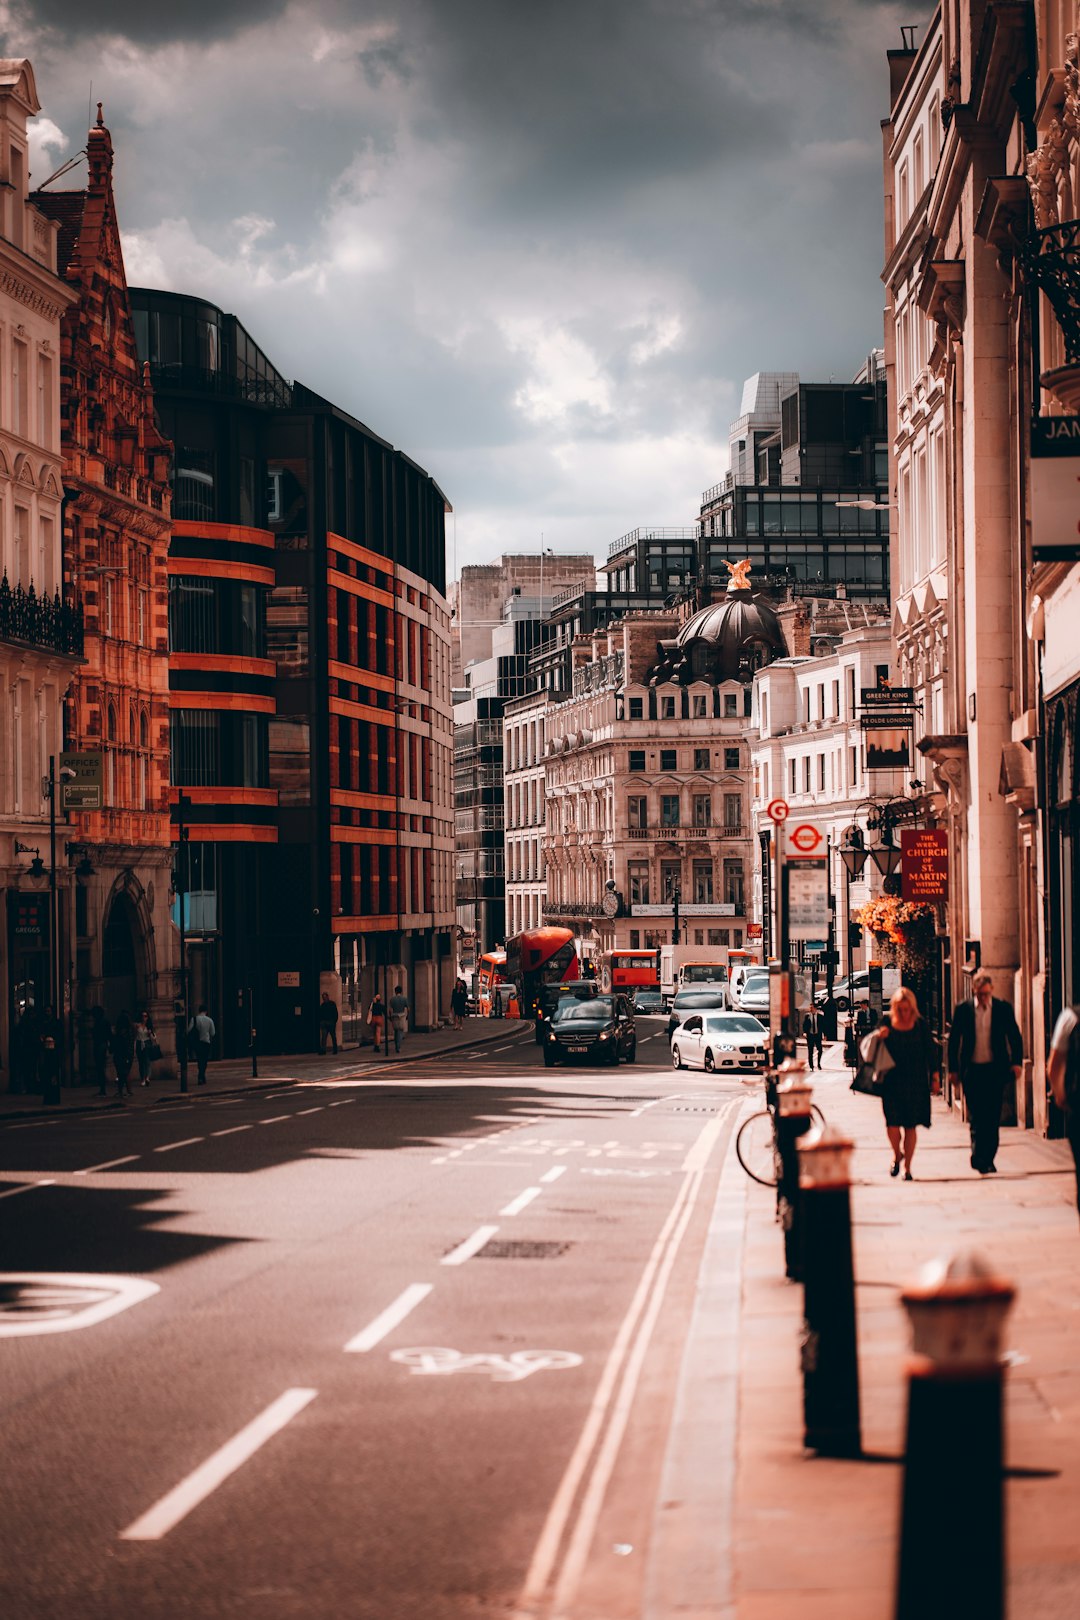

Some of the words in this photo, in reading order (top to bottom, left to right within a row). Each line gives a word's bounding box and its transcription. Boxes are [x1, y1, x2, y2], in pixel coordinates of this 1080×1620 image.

[64, 759, 99, 767] OFFICES
[770, 801, 787, 820] G
[906, 848, 948, 857] CHURCH
[909, 872, 948, 881] MARTIN
[549, 961, 559, 969] 76
